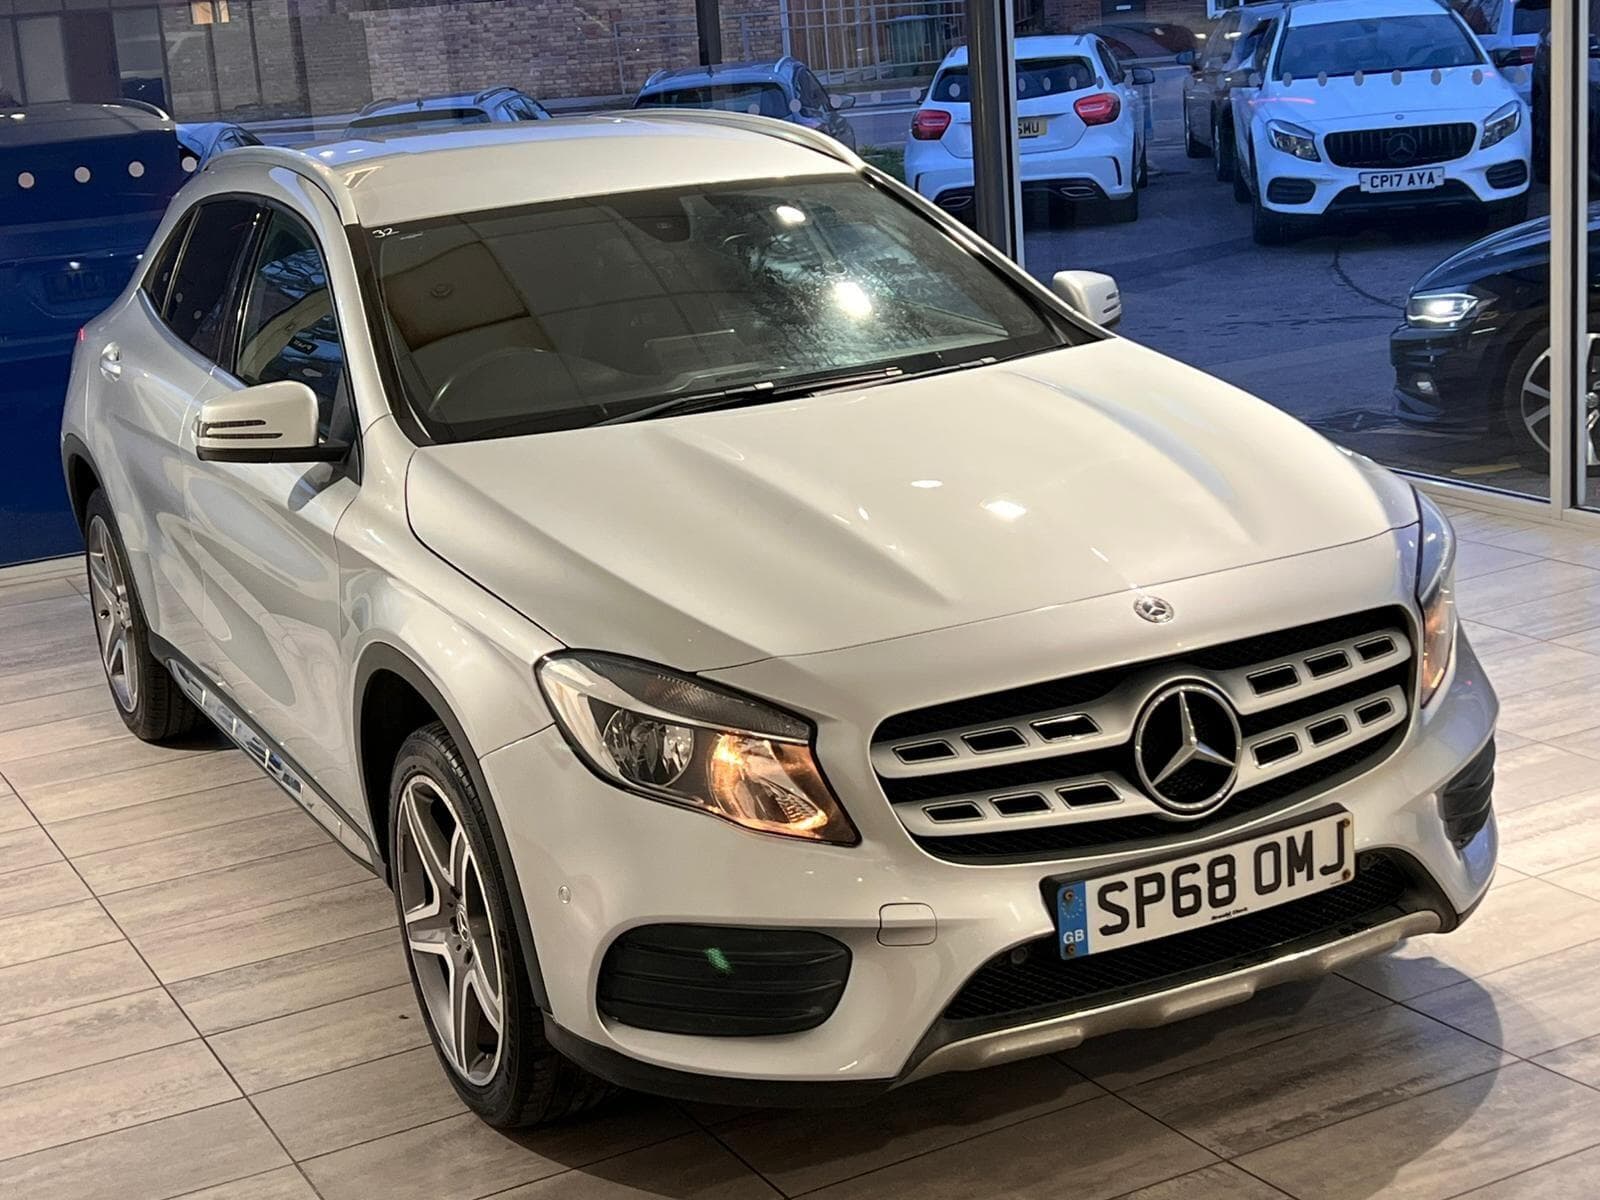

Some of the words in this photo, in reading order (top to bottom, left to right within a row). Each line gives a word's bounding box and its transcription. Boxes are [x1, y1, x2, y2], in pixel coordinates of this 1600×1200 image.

[1370, 174, 1403, 188] CP17
[1407, 171, 1434, 185] AYA
[372, 227, 400, 238] 32
[1097, 854, 1237, 936] SP68
[1253, 820, 1346, 896] OMJ
[1063, 928, 1084, 945] GB
